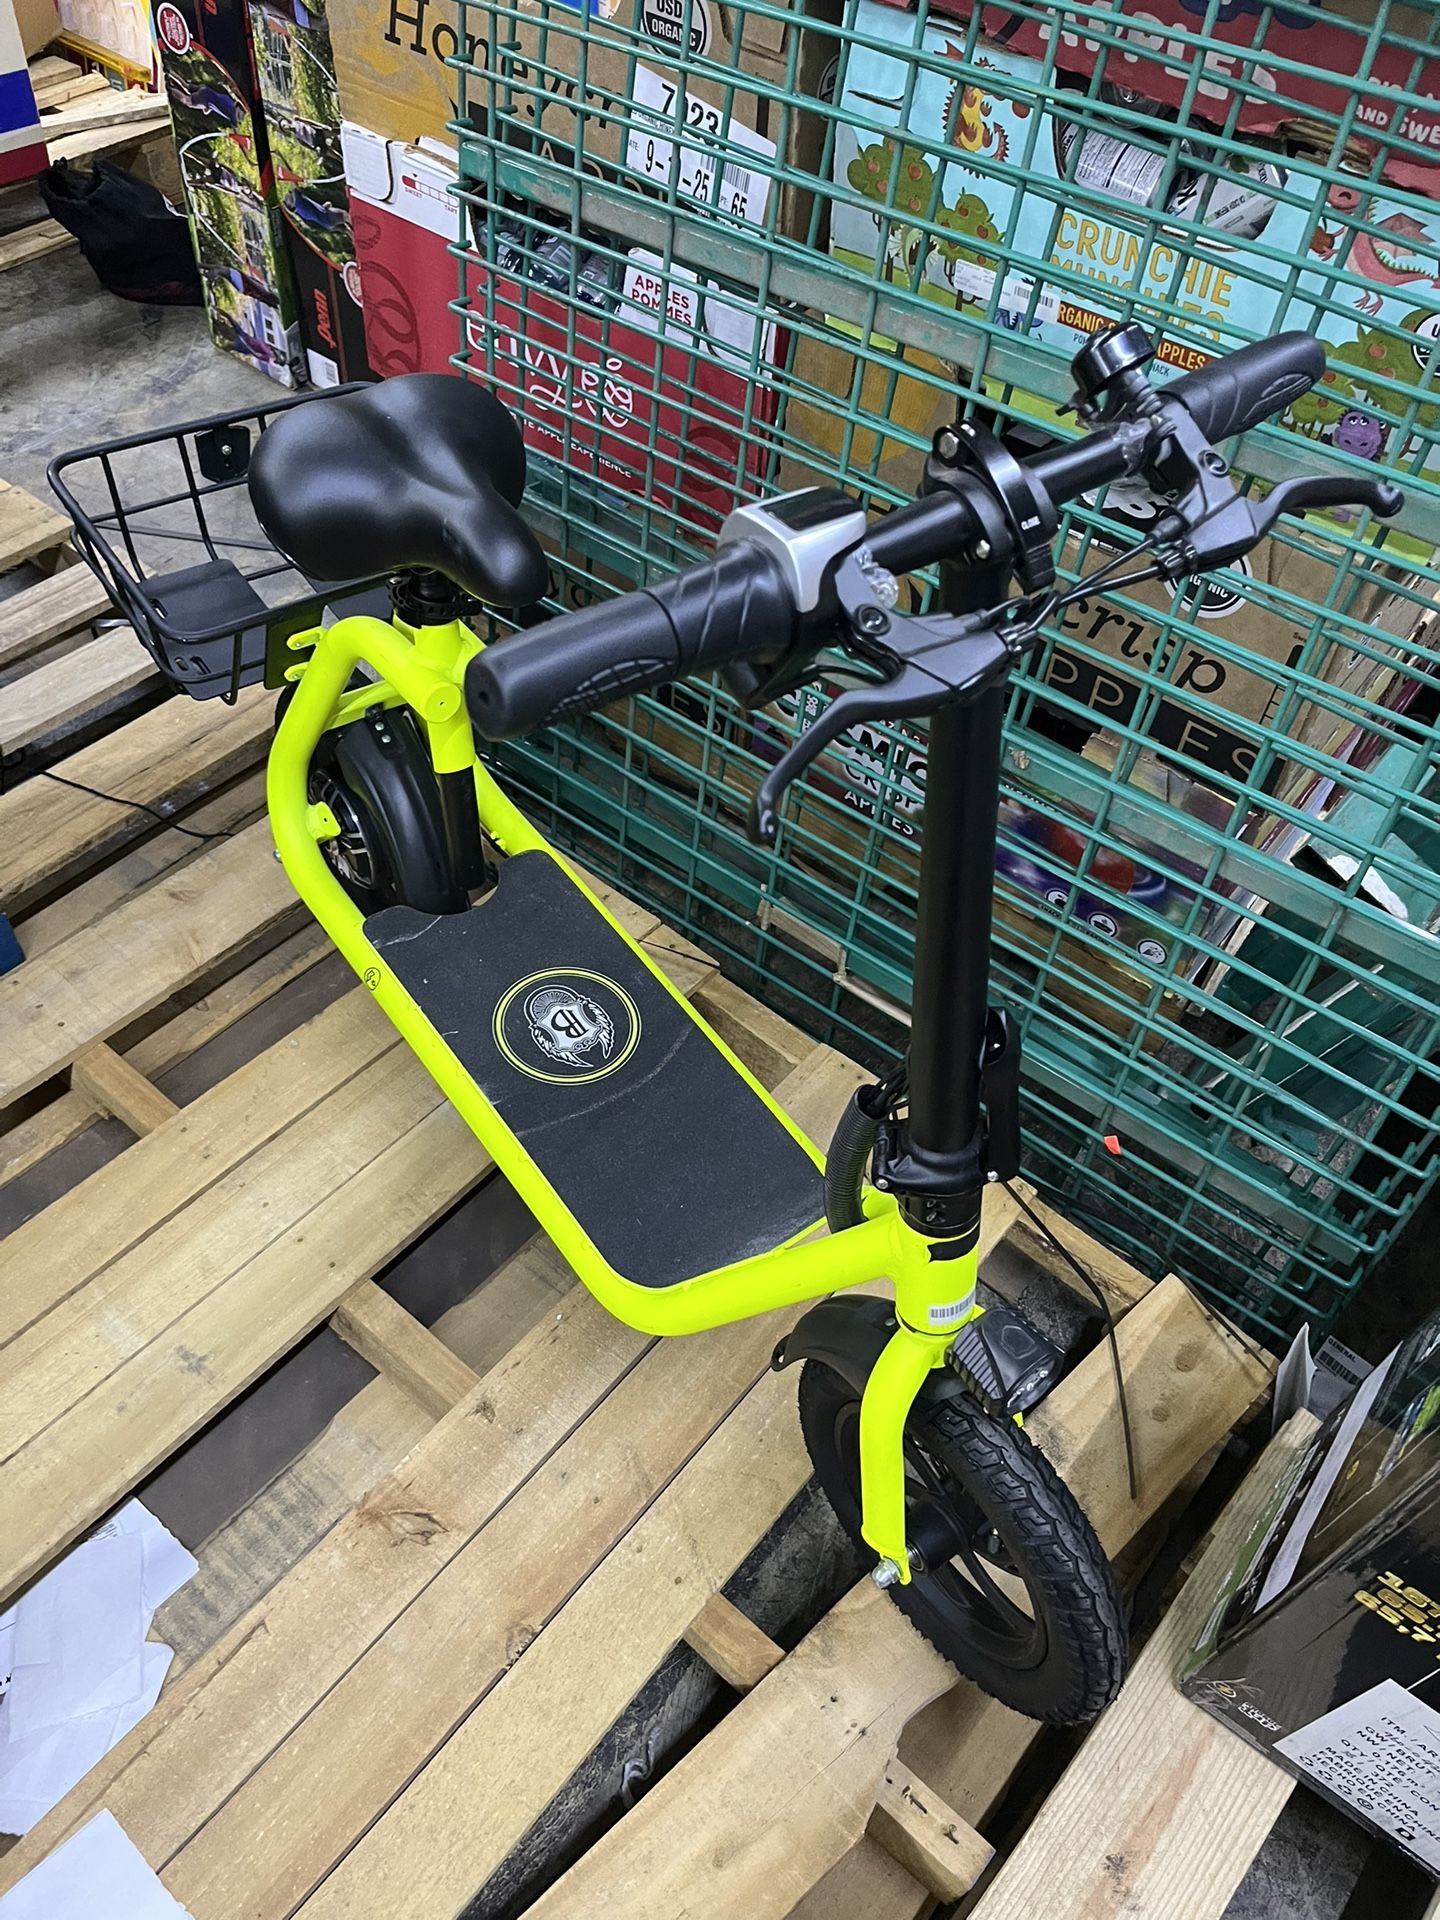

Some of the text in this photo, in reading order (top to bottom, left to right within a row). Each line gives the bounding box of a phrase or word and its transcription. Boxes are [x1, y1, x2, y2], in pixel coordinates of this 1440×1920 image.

[651, 20, 696, 47] ORGAC
[656, 0, 689, 18] USD
[1038, 1, 1277, 105] APPLES
[661, 83, 719, 148] 723
[1355, 104, 1388, 126] AND
[1056, 213, 1238, 307] CRUNCHIE
[635, 274, 690, 309] APPES
[1312, 1754, 1415, 1831] HECHO EN CHINA
[1325, 1747, 1418, 1816] MADE IN CHINA
[1384, 1799, 1403, 1812] EN
